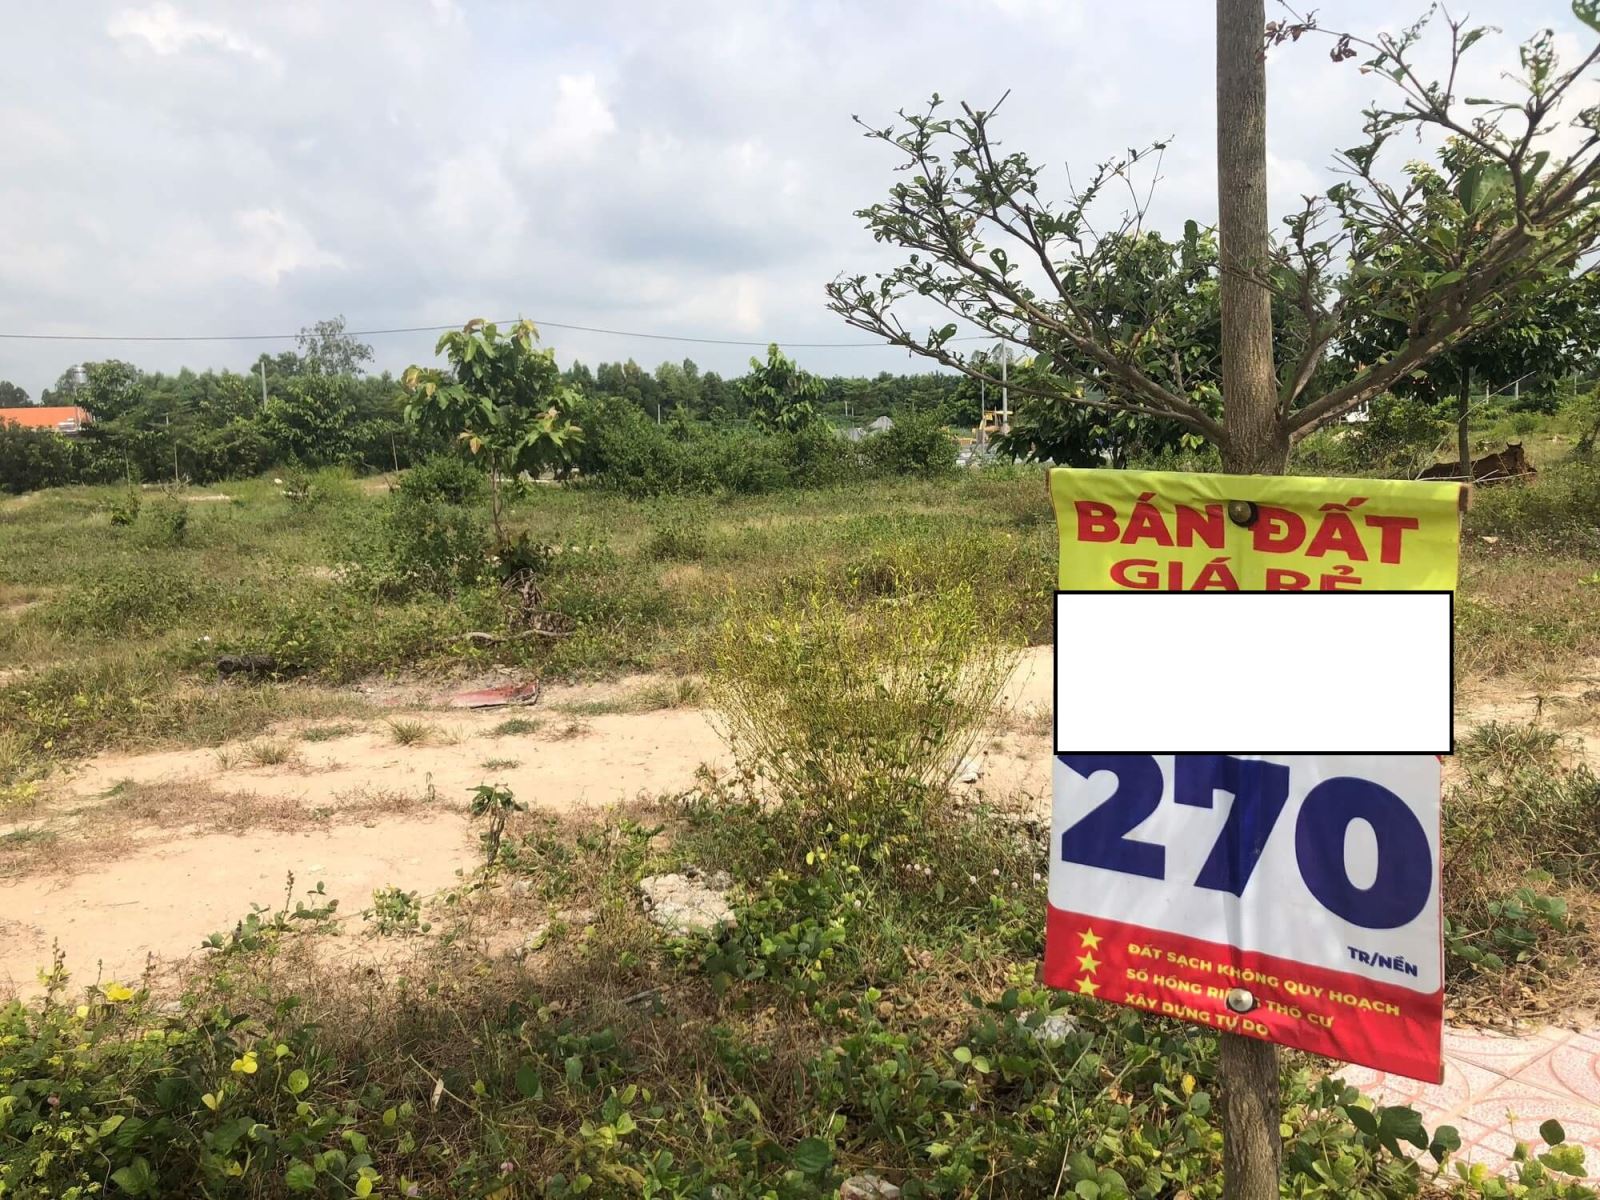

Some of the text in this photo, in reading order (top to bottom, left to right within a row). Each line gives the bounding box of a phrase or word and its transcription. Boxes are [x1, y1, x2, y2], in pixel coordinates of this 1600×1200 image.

[1074, 492, 1419, 564] BÁN ĐẤT
[1110, 557, 1240, 590] GIÁ
[1057, 755, 1433, 930] 270
[1125, 991, 1269, 1036] XÂY DỰNG TỰ DO
[1127, 943, 1162, 960] ĐẤT
[1166, 951, 1212, 972] SẠCH
[1217, 963, 1279, 988] KHÔNG
[1280, 979, 1324, 998] QUY
[1328, 990, 1400, 1016] HOẠCH
